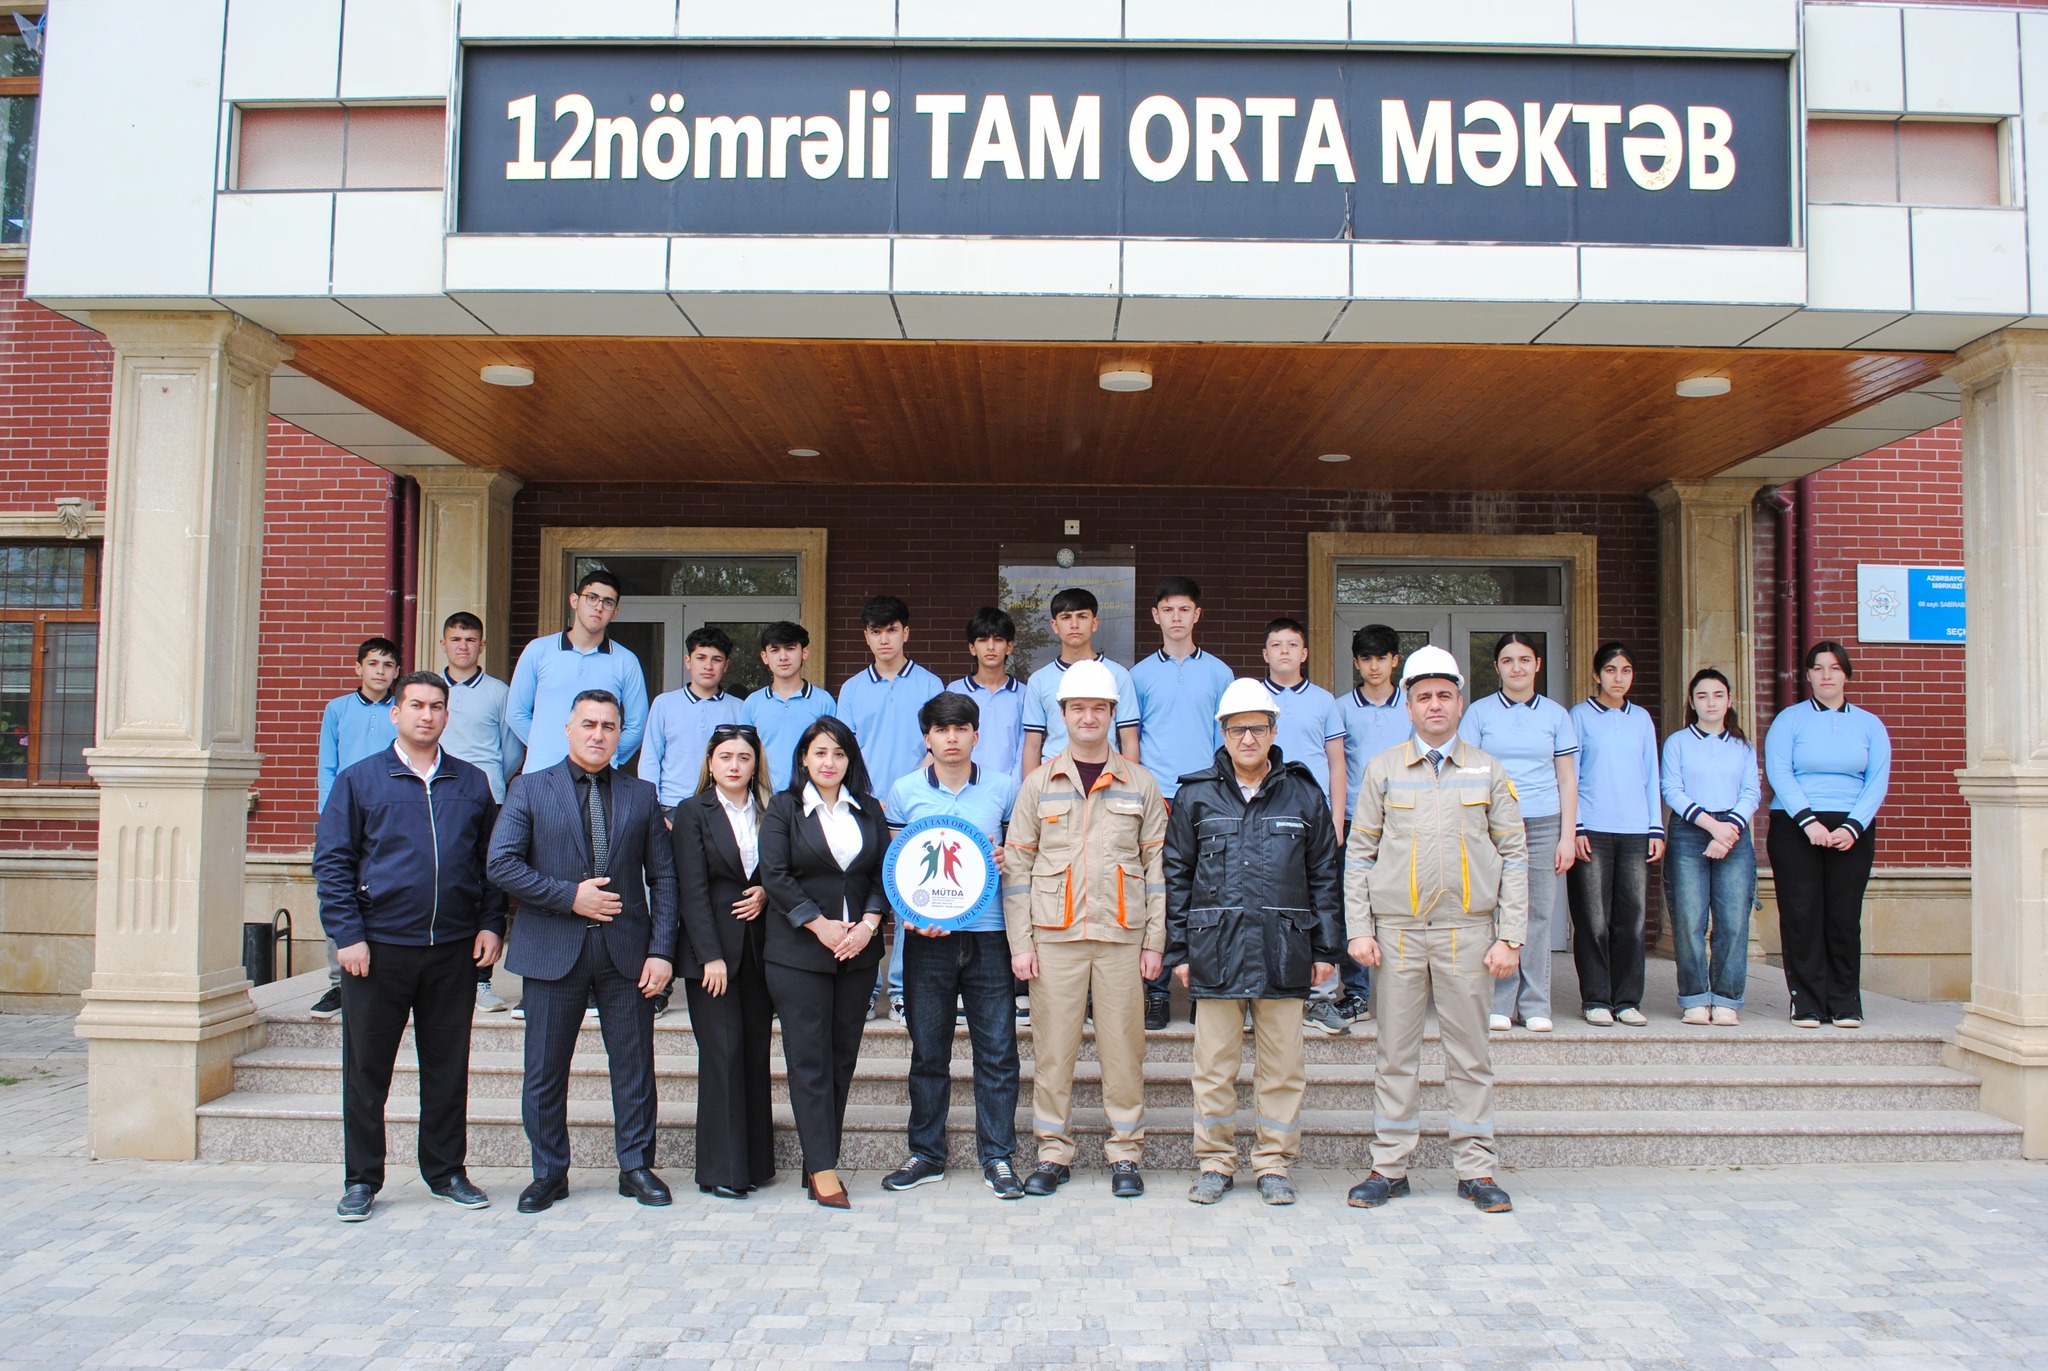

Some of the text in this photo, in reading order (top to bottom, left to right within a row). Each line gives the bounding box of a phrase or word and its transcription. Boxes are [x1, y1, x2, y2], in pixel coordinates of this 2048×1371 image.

[505, 88, 1737, 192] 12nömrəli TAM ORTA MƏKTƏB
[951, 819, 974, 835] ORTA
[931, 888, 964, 897] MÜTDA
